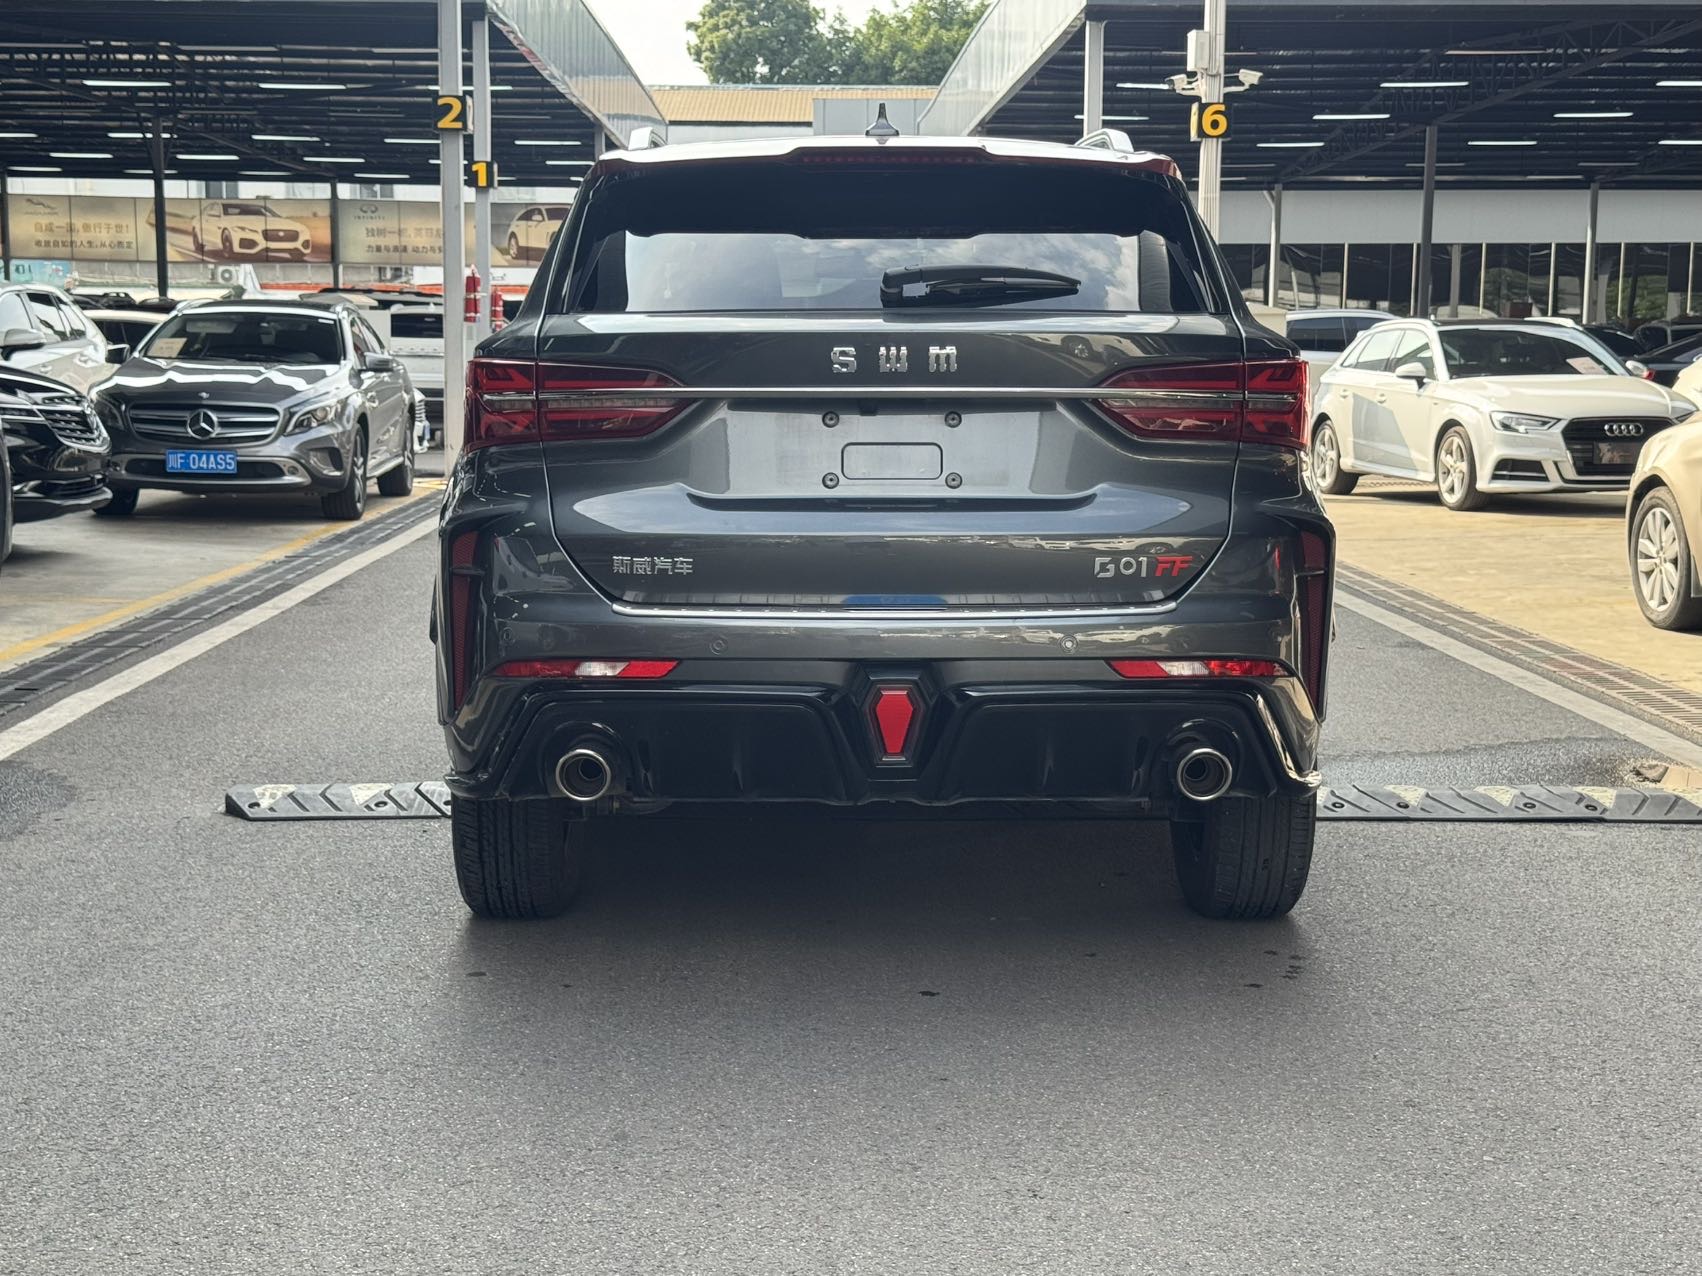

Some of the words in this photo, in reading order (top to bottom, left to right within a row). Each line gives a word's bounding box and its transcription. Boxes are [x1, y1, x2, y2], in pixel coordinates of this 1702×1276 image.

[437, 97, 463, 129] 2
[1202, 104, 1228, 137] 6
[472, 162, 487, 187] 1
[612, 556, 694, 575] 斯威汽车
